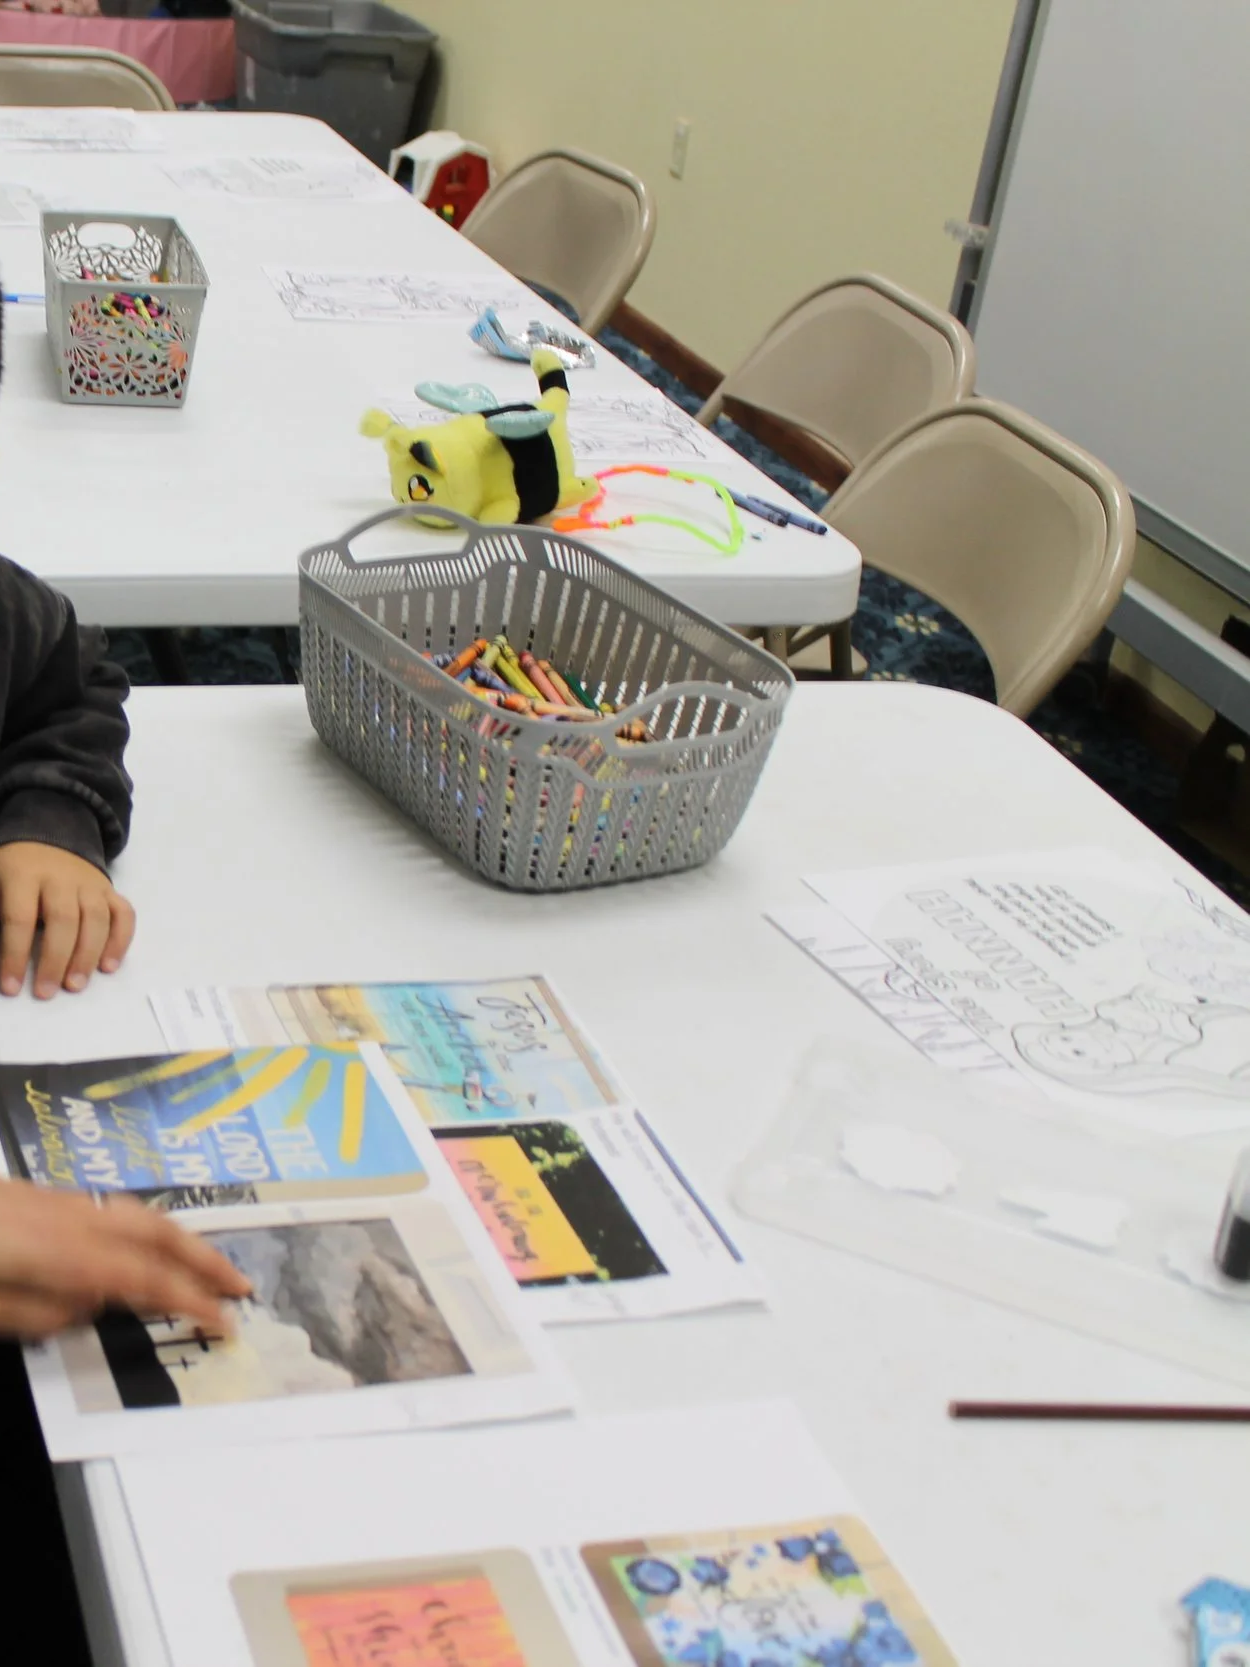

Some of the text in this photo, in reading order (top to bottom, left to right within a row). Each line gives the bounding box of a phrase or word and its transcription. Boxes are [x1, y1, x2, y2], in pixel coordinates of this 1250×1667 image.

[905, 889, 1089, 1019] HANNAH
[476, 991, 548, 1052] Jesus
[61, 1096, 126, 1188] AND MY
[158, 1127, 200, 1149] IS
[213, 1115, 271, 1180] LORD
[265, 1121, 329, 1178] THE
